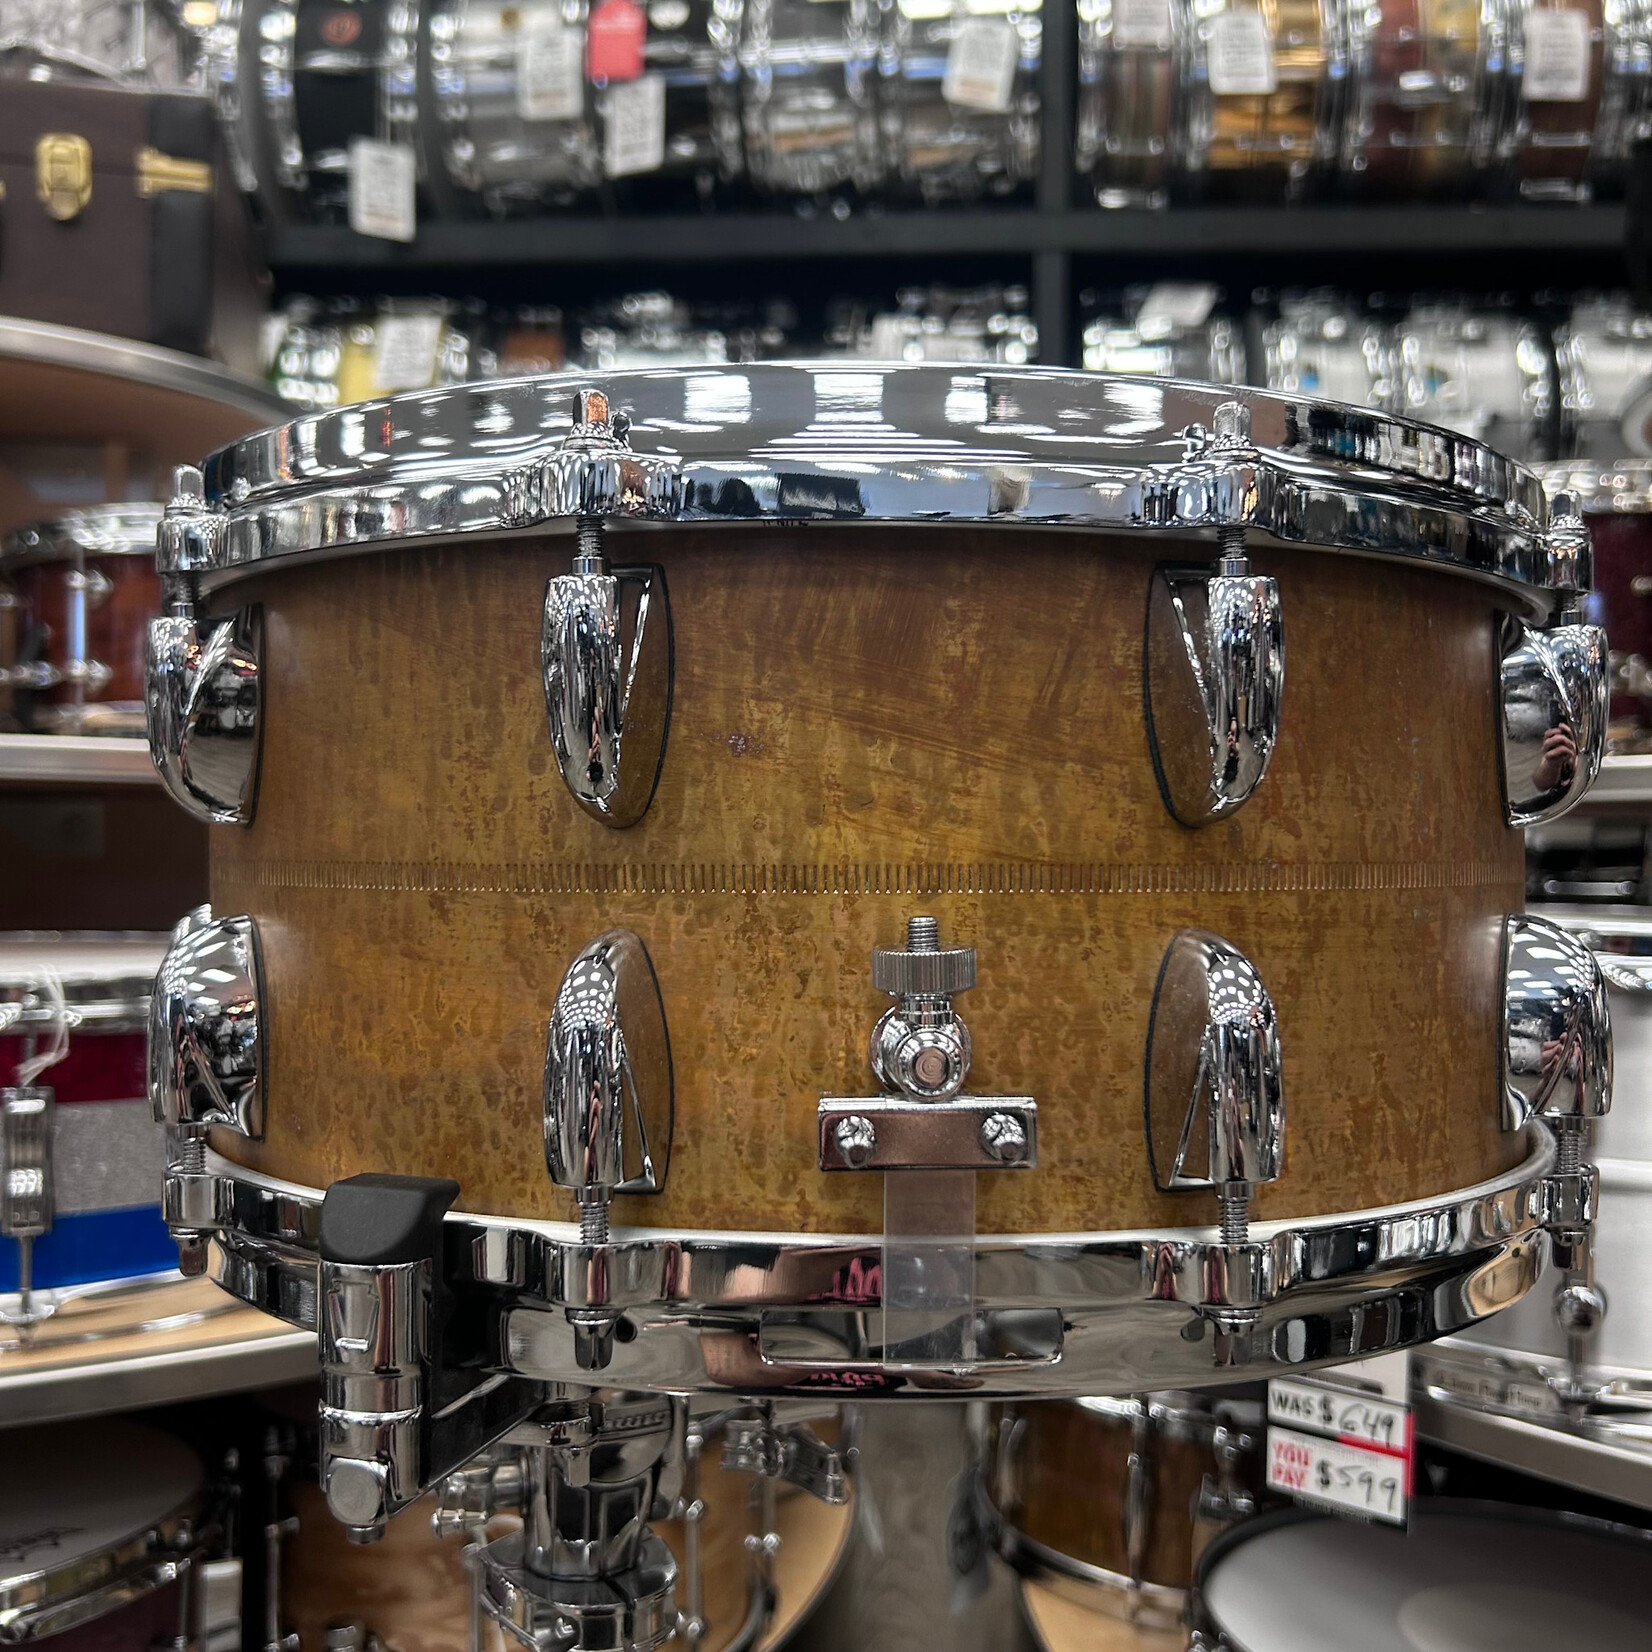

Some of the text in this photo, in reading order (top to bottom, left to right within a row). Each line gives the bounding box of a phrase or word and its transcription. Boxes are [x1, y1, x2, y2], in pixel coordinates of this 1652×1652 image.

[1271, 1389, 1316, 1416] WAS
[1272, 1441, 1309, 1467] YOU
[1272, 1463, 1305, 1489] PAY
